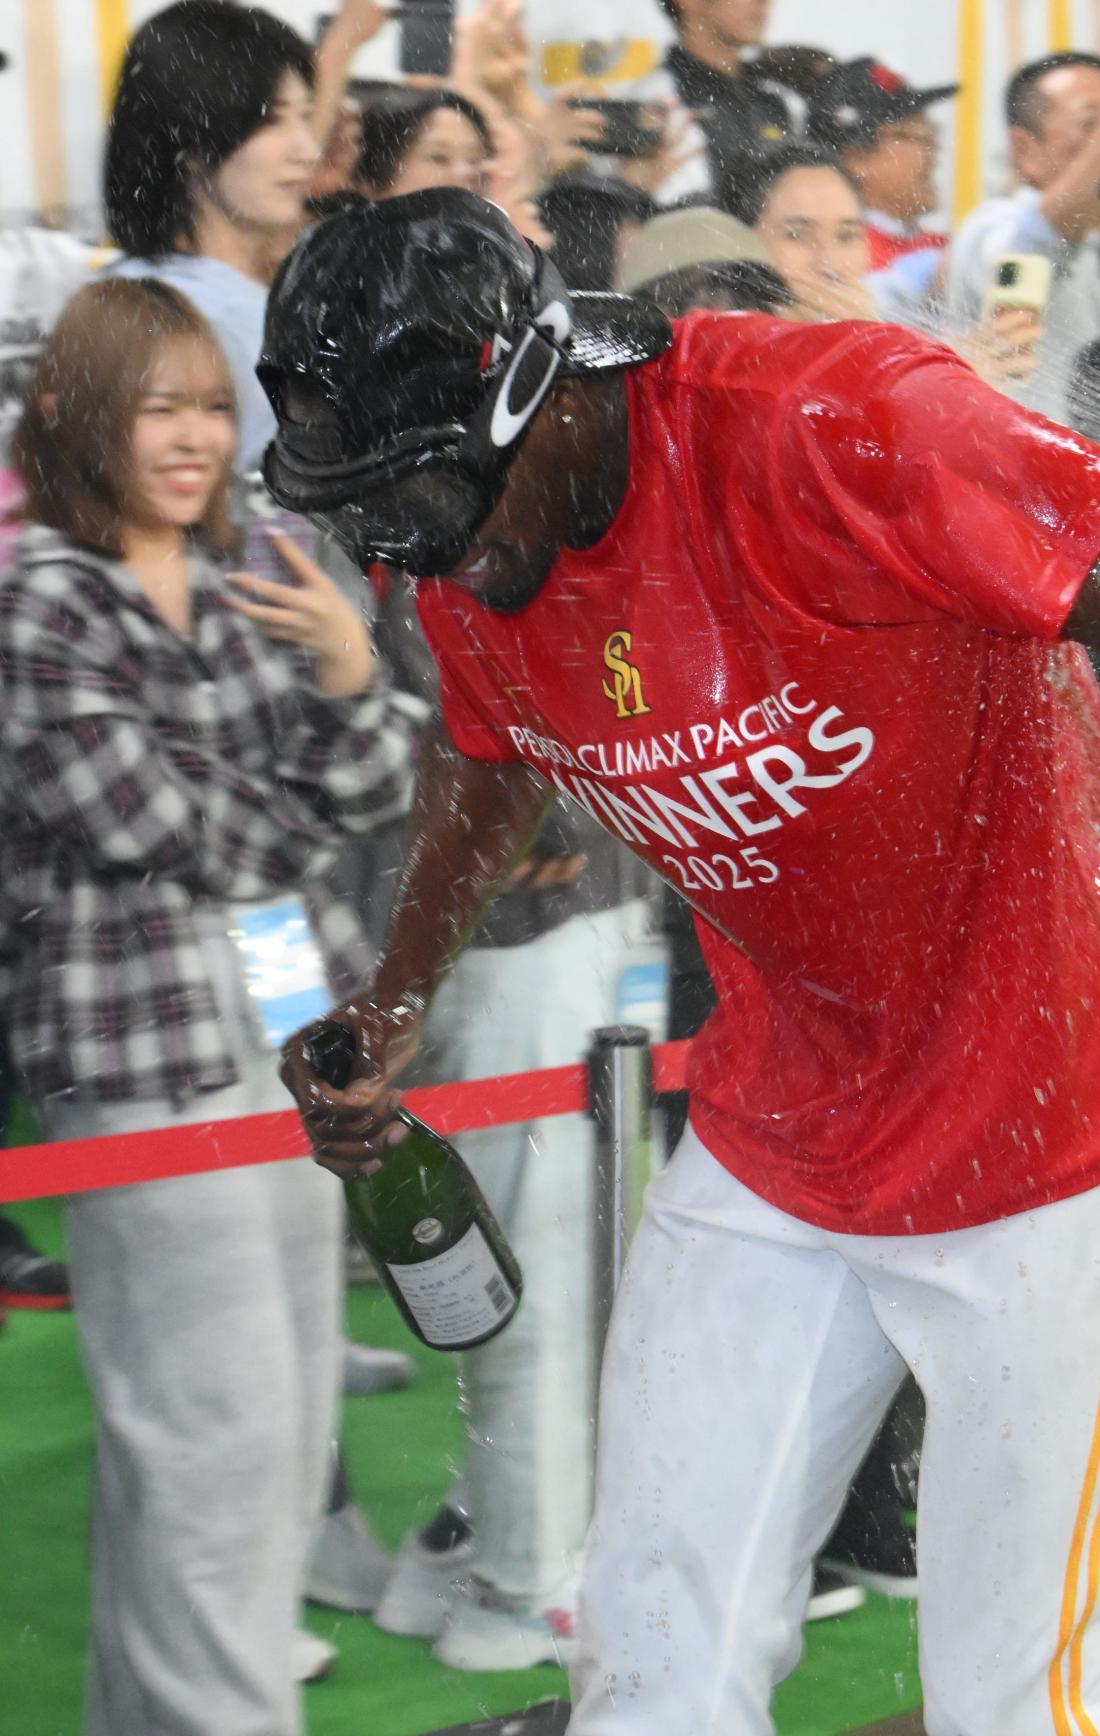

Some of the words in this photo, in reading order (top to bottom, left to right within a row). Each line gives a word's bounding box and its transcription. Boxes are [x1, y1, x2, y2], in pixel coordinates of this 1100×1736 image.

[578, 732, 690, 776] CLIMAX
[690, 681, 818, 760] PACIFIC
[663, 846, 780, 891] 2025
